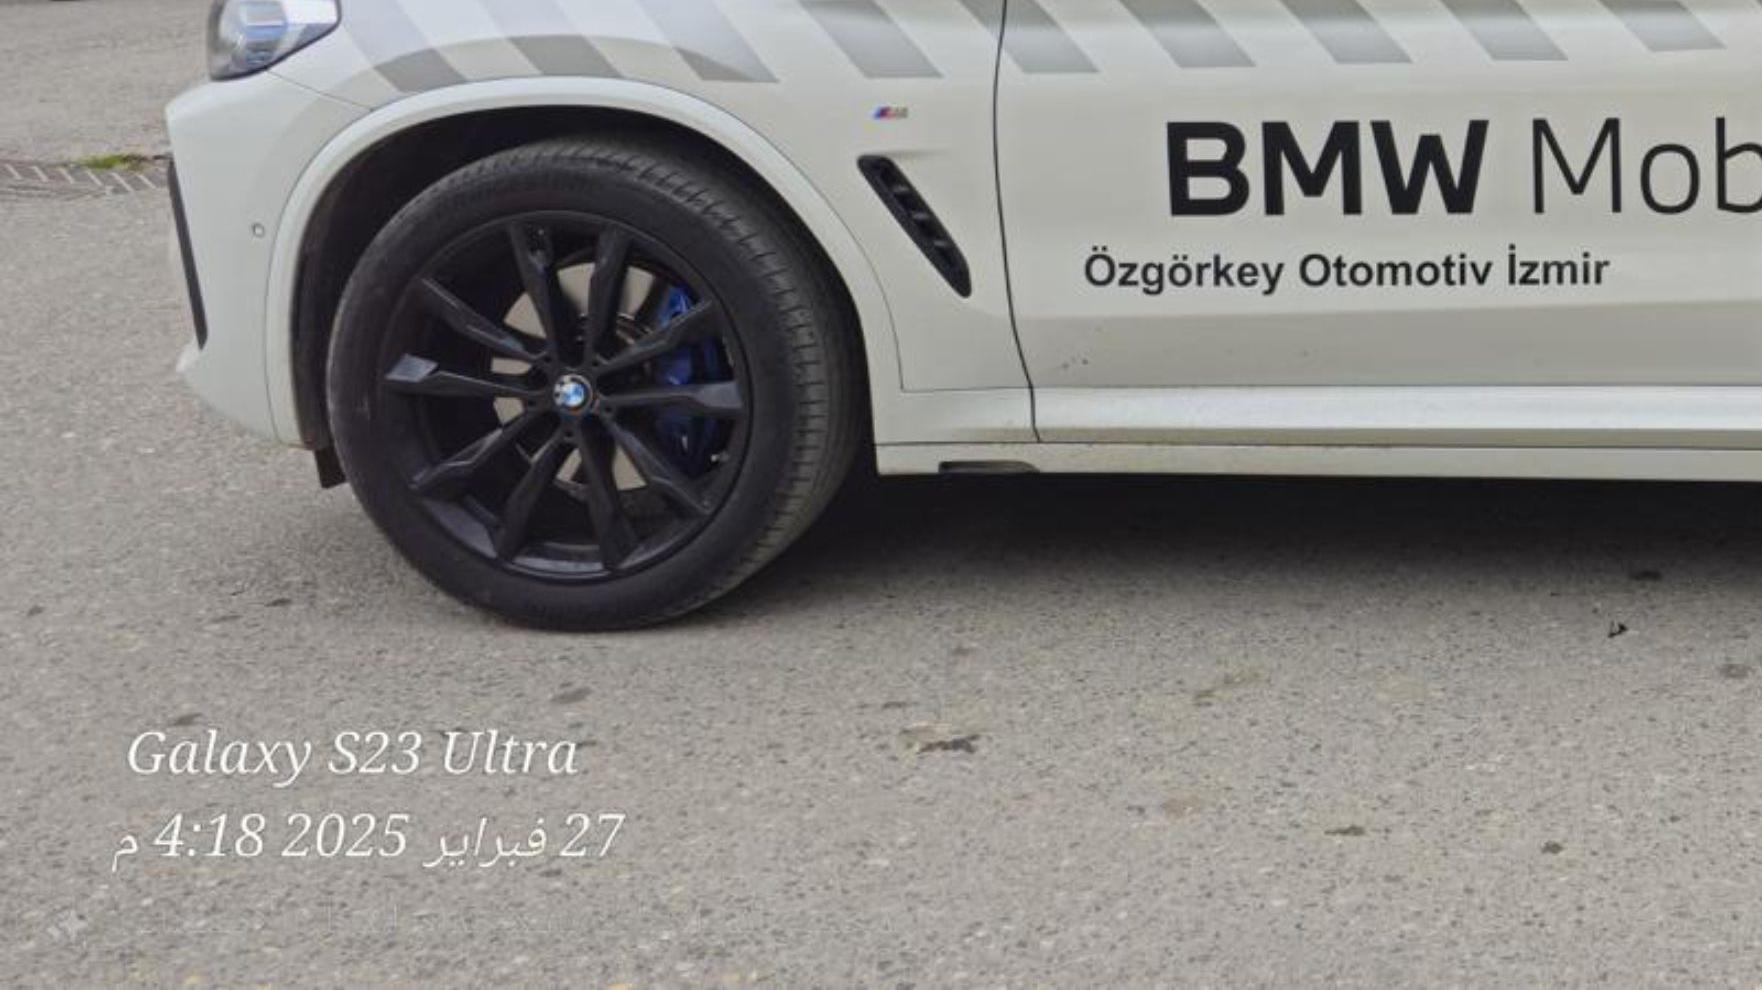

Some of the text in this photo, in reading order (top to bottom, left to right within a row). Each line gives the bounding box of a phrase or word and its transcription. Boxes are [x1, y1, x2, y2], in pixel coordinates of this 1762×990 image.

[1166, 119, 1490, 216] BMW
[1084, 244, 1611, 296] Özgörkey Otomotiv İzmir
